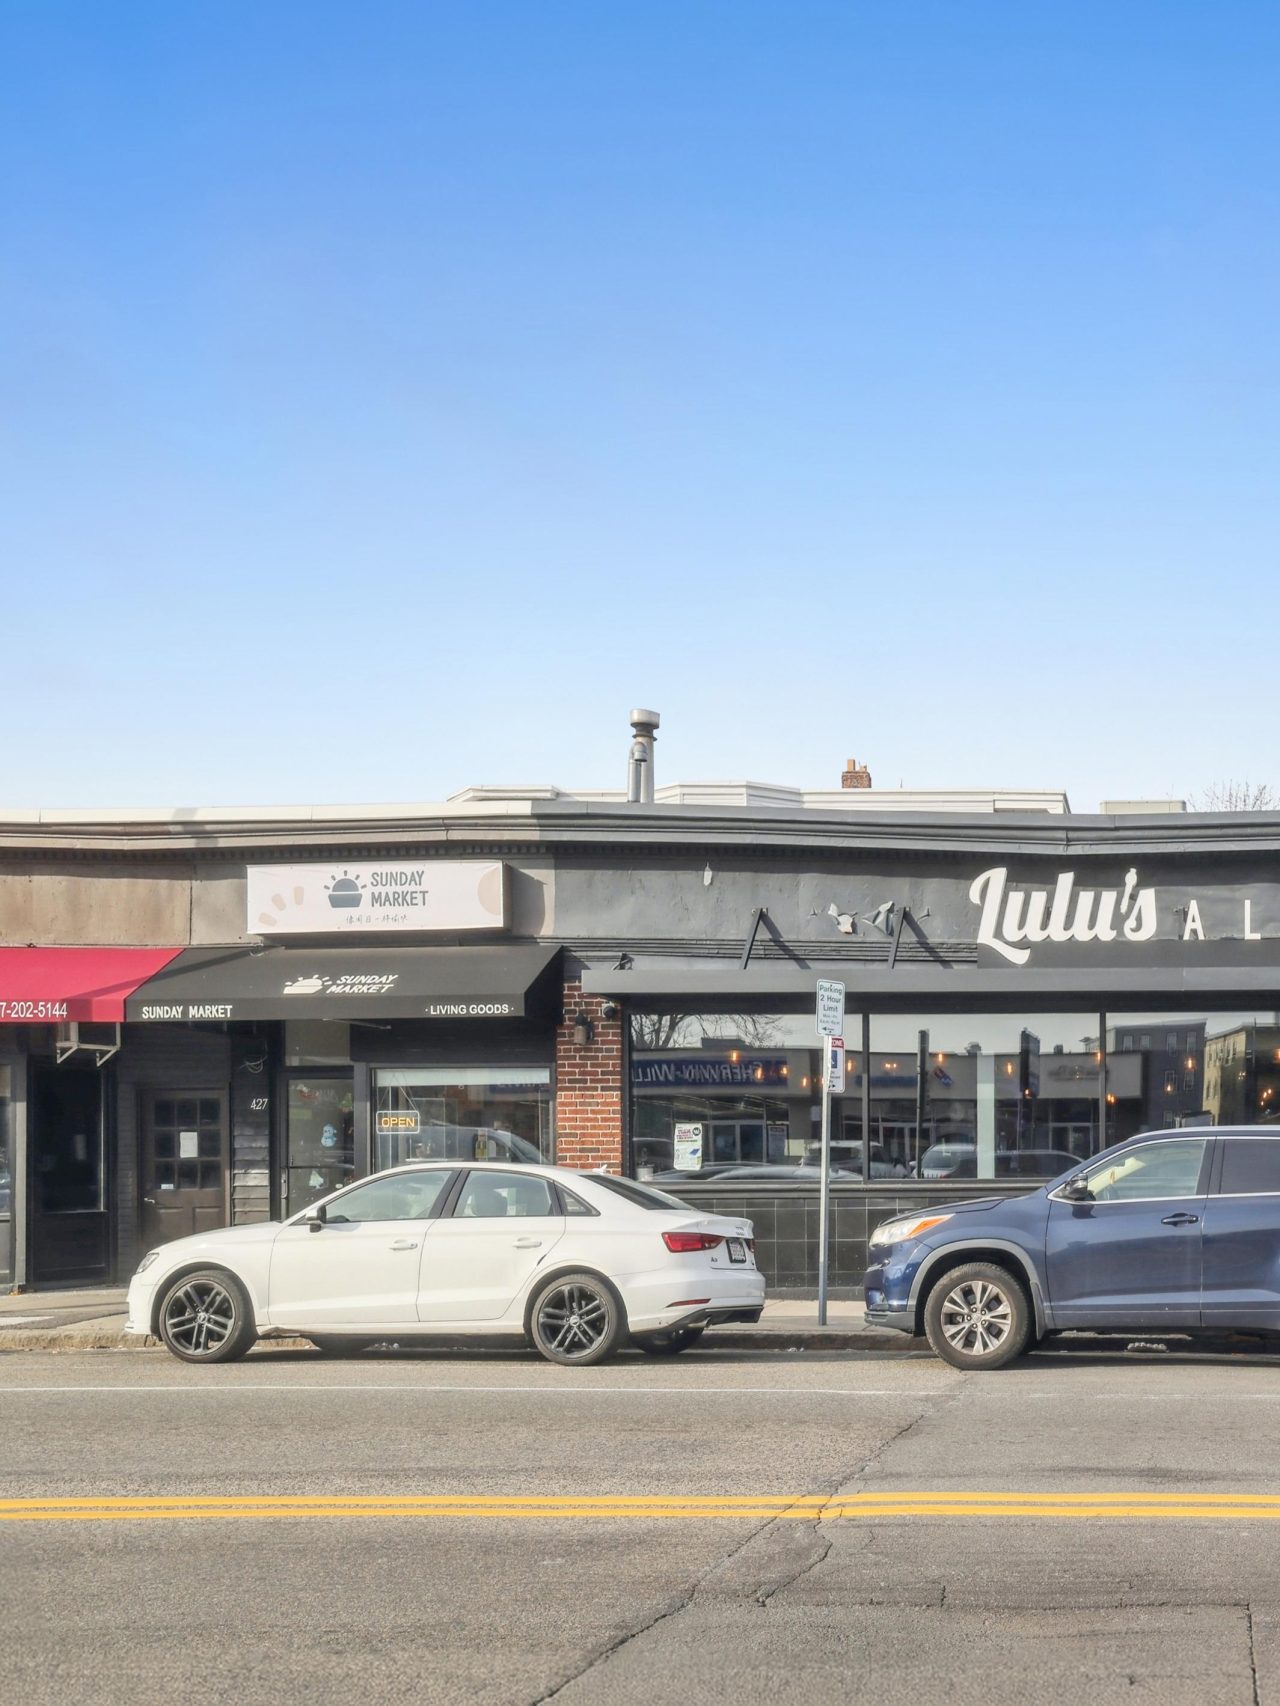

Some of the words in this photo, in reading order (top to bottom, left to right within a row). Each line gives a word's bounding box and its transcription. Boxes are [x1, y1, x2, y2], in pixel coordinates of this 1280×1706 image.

[370, 870, 425, 887] SUNDAY
[371, 890, 429, 908] MARKET
[968, 867, 1157, 965] Lulu's
[336, 974, 399, 985] SUNDAY
[325, 984, 395, 994] MARKET
[820, 984, 843, 996] Parking
[820, 993, 825, 1002] 2
[827, 994, 842, 1004] Hour
[0, 1001, 68, 1019] 7-202-5144
[142, 1005, 183, 1020] SUNDAY
[189, 1004, 233, 1019] MARKET
[430, 1004, 467, 1015] LIVING
[469, 1003, 509, 1014] GOODS
[823, 1003, 838, 1013] Limit
[250, 1098, 268, 1110] 427
[381, 1116, 416, 1129] OPEN
